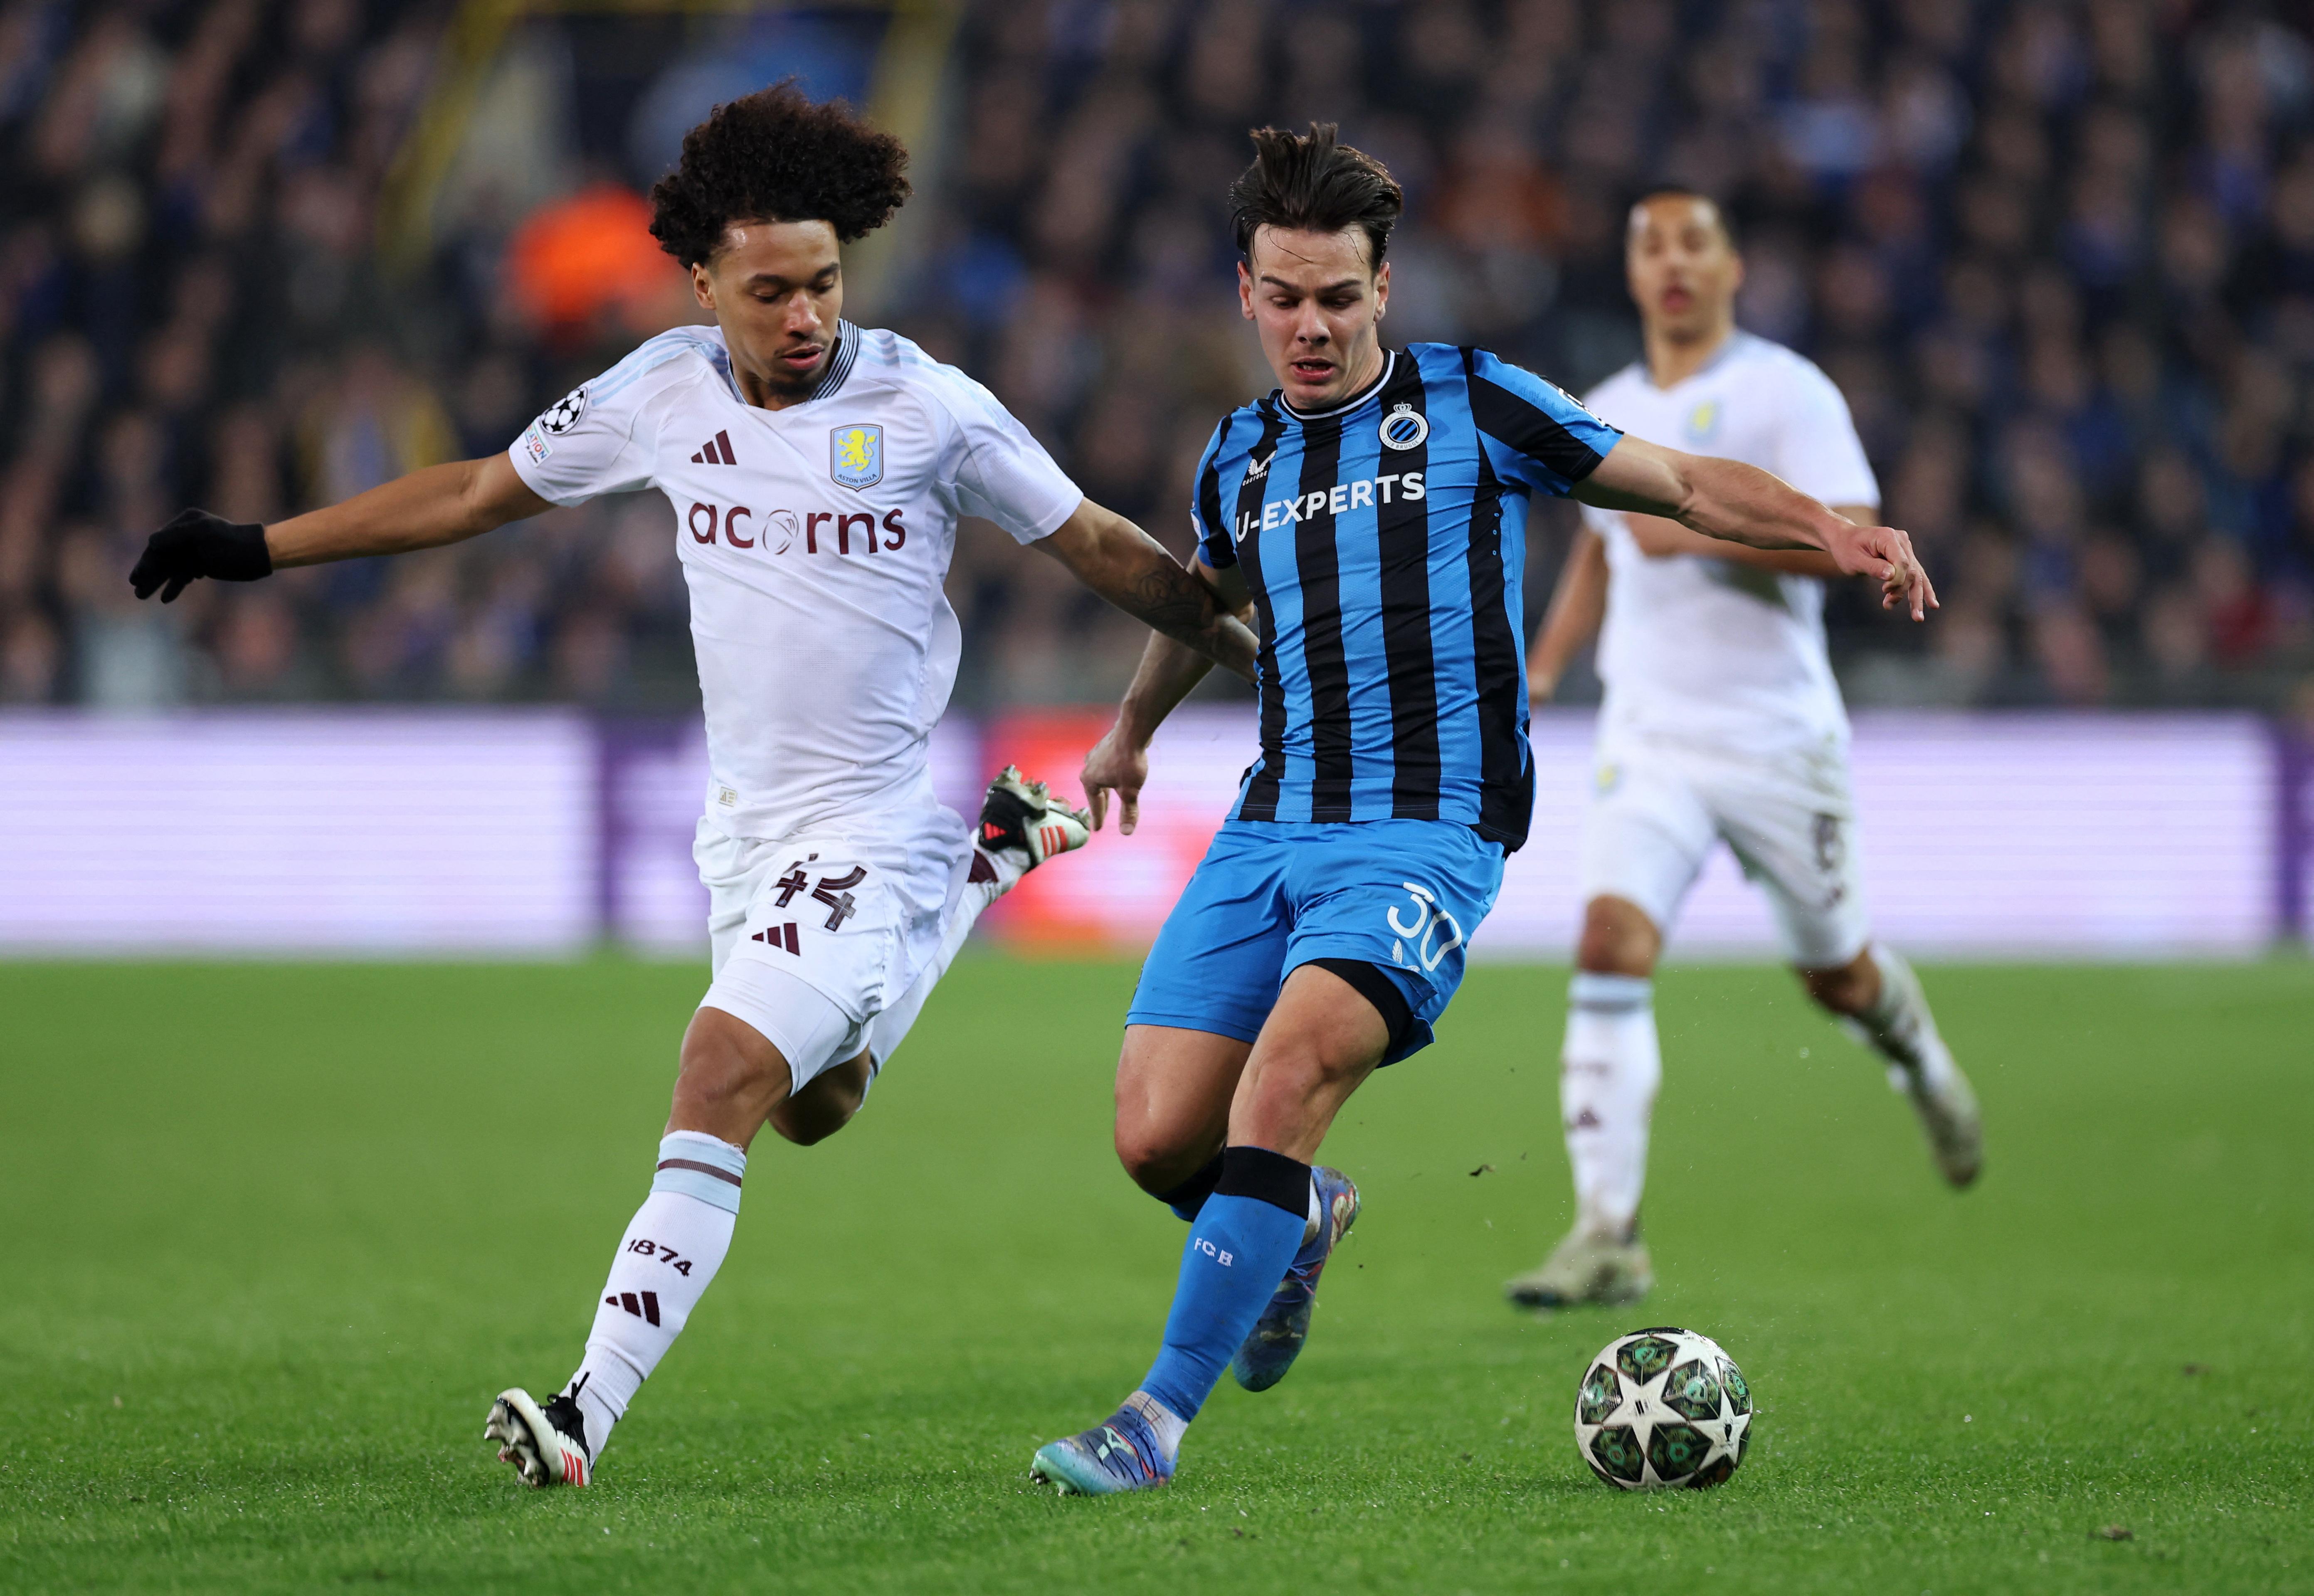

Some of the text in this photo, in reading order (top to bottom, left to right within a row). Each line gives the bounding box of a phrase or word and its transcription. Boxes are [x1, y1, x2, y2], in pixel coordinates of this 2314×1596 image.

[1383, 437, 1394, 447] CLUB
[1396, 440, 1419, 449] BRUGGE
[837, 474, 878, 483] ASTON VILLA
[1242, 470, 1268, 486] CASTORE
[688, 502, 905, 555] acorns
[1235, 472, 1426, 543] U-EXPERTS
[770, 853, 868, 932] 44
[1387, 882, 1463, 972] 30
[627, 1239, 693, 1277] 1874
